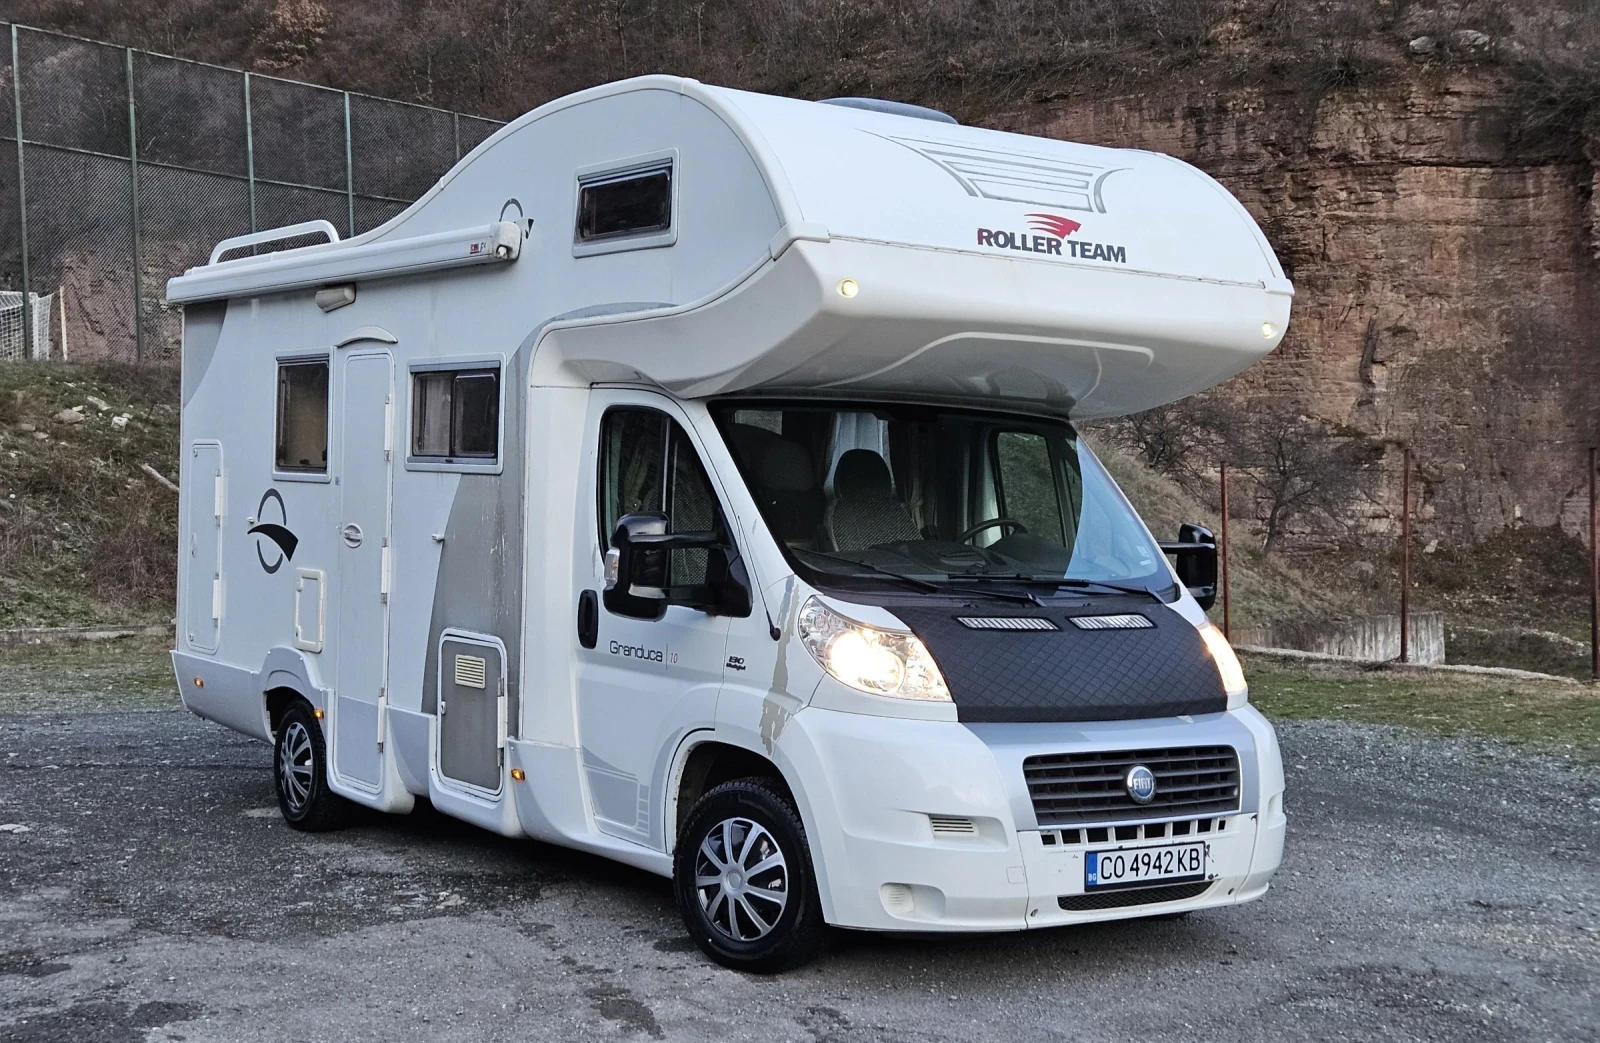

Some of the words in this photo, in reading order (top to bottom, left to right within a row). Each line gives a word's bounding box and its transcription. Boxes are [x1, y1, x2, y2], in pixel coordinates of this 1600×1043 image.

[977, 228, 1062, 255] ROLLER
[1067, 240, 1126, 263] TEAM
[609, 640, 663, 662] Granduca
[670, 652, 679, 664] 10
[1133, 777, 1150, 790] FIAT
[1100, 855, 1126, 880] CO
[1129, 850, 1174, 877] 4942
[1177, 848, 1201, 873] KB
[1088, 873, 1097, 881] BG
